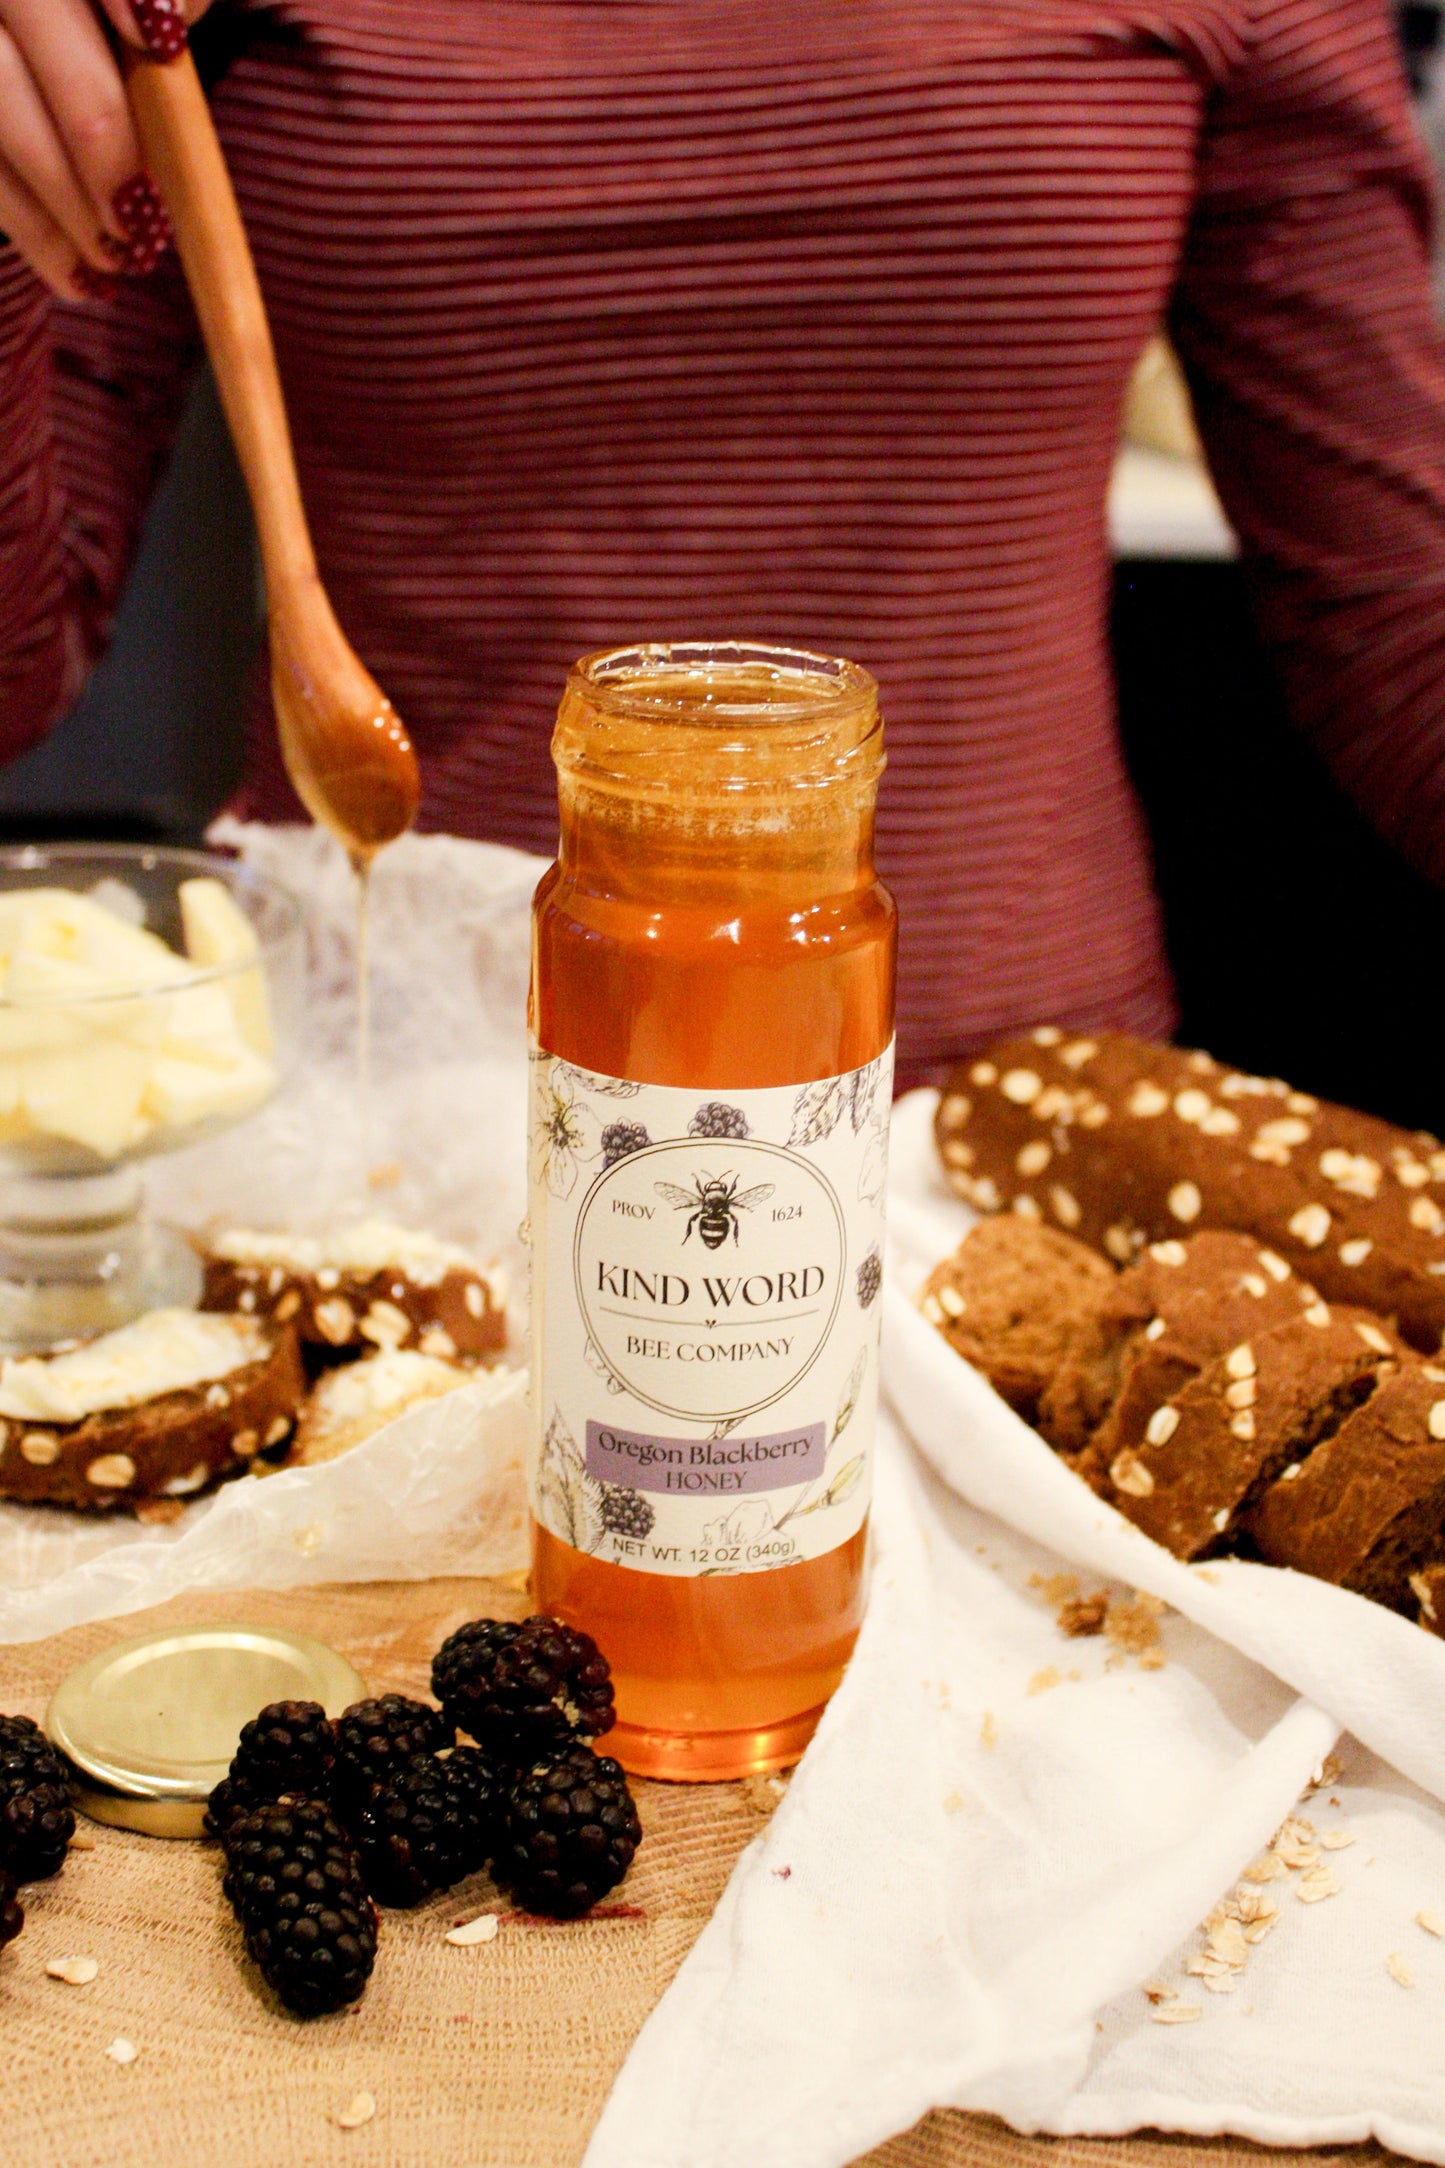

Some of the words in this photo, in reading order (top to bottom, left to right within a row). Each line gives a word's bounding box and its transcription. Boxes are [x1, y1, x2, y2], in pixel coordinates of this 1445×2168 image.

[612, 1199, 657, 1221] PROV
[771, 1205, 803, 1223] 1624
[597, 1260, 690, 1307] KIND
[702, 1264, 825, 1308] WORD
[626, 1334, 671, 1361] BEE
[676, 1335, 795, 1363] COMPANY
[599, 1431, 683, 1467] Oregon
[688, 1436, 813, 1466] Blackberry
[665, 1470, 749, 1490] HONEY
[612, 1537, 645, 1558] NET
[651, 1546, 682, 1563] WT.
[690, 1549, 709, 1563] 12
[714, 1547, 741, 1562] OZ
[745, 1538, 796, 1562] (340g)
